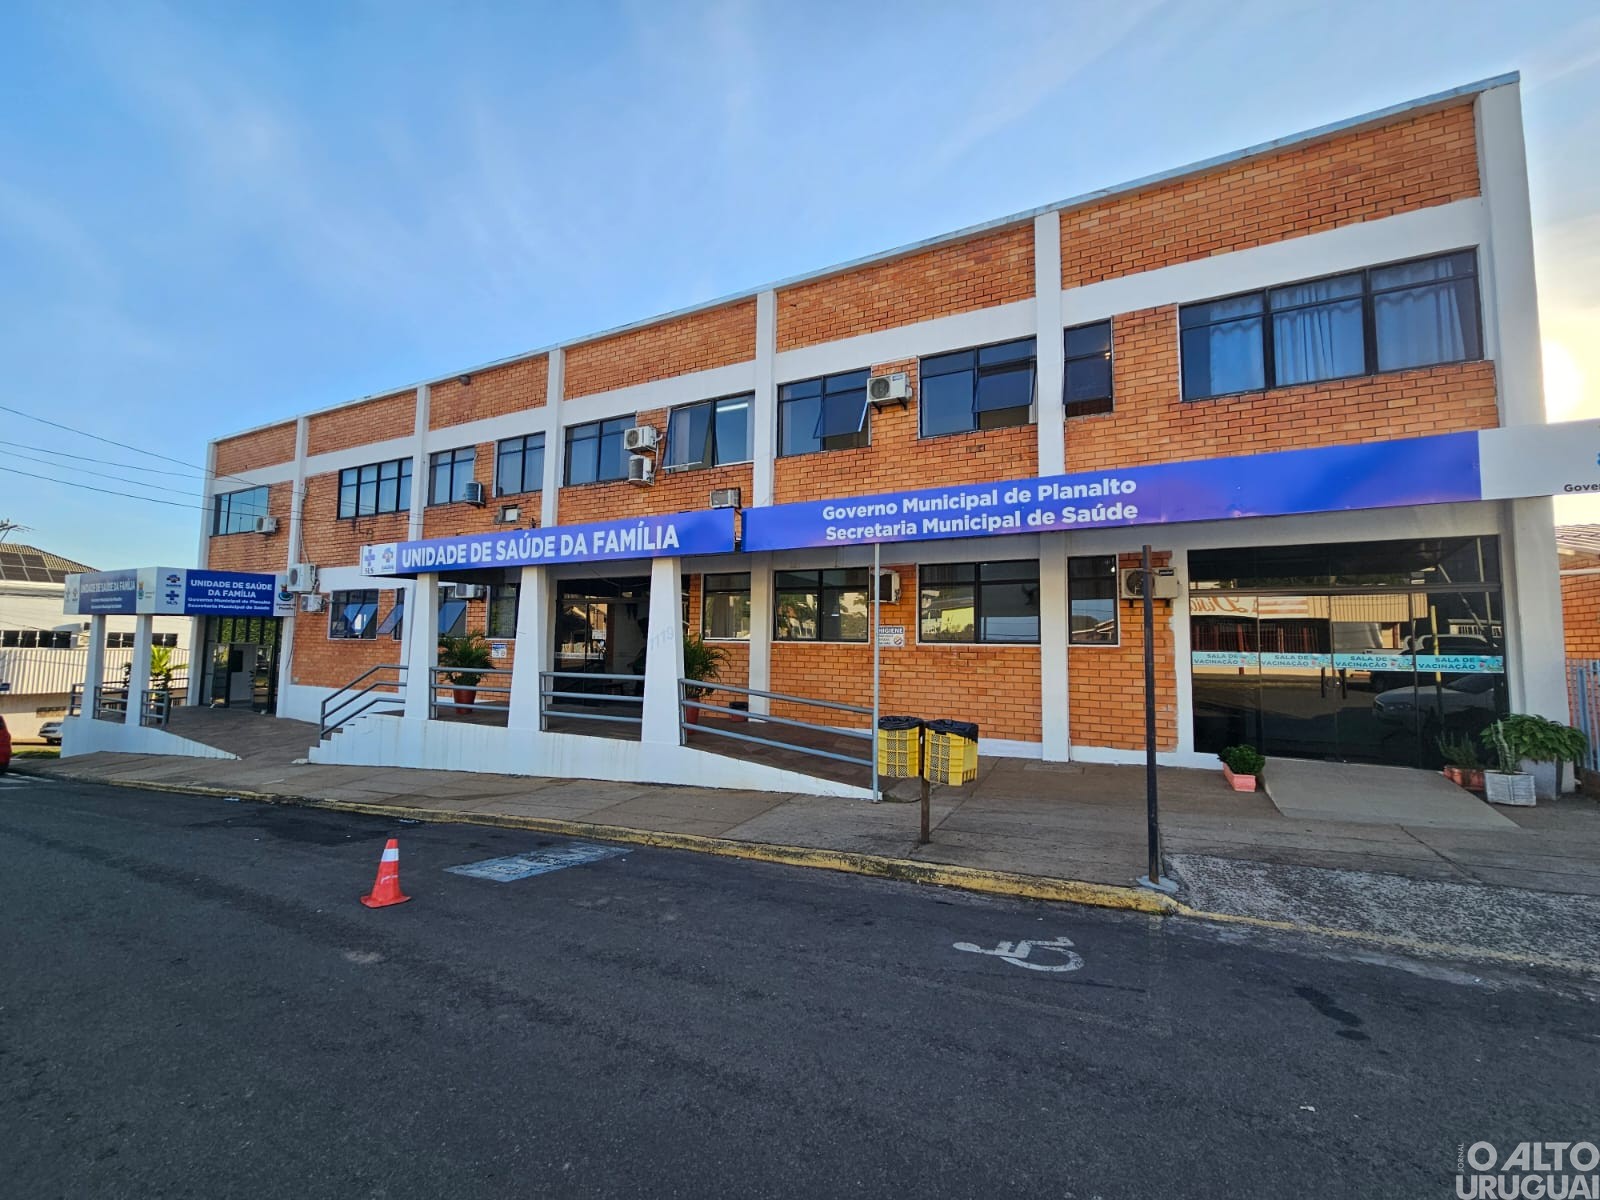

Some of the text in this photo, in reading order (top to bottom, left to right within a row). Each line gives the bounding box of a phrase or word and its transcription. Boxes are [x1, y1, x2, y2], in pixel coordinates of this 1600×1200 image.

[823, 478, 1137, 520] Governo Municipal de Planalto
[826, 502, 1138, 541] Secretaria Municipal de Saúde
[402, 520, 680, 568] UNIDADE DE SAÚDE DA FAMÍLIA
[190, 579, 231, 588] UNIDADE
[245, 581, 273, 590] SAÚDE
[222, 588, 257, 598] FAMÍLIA
